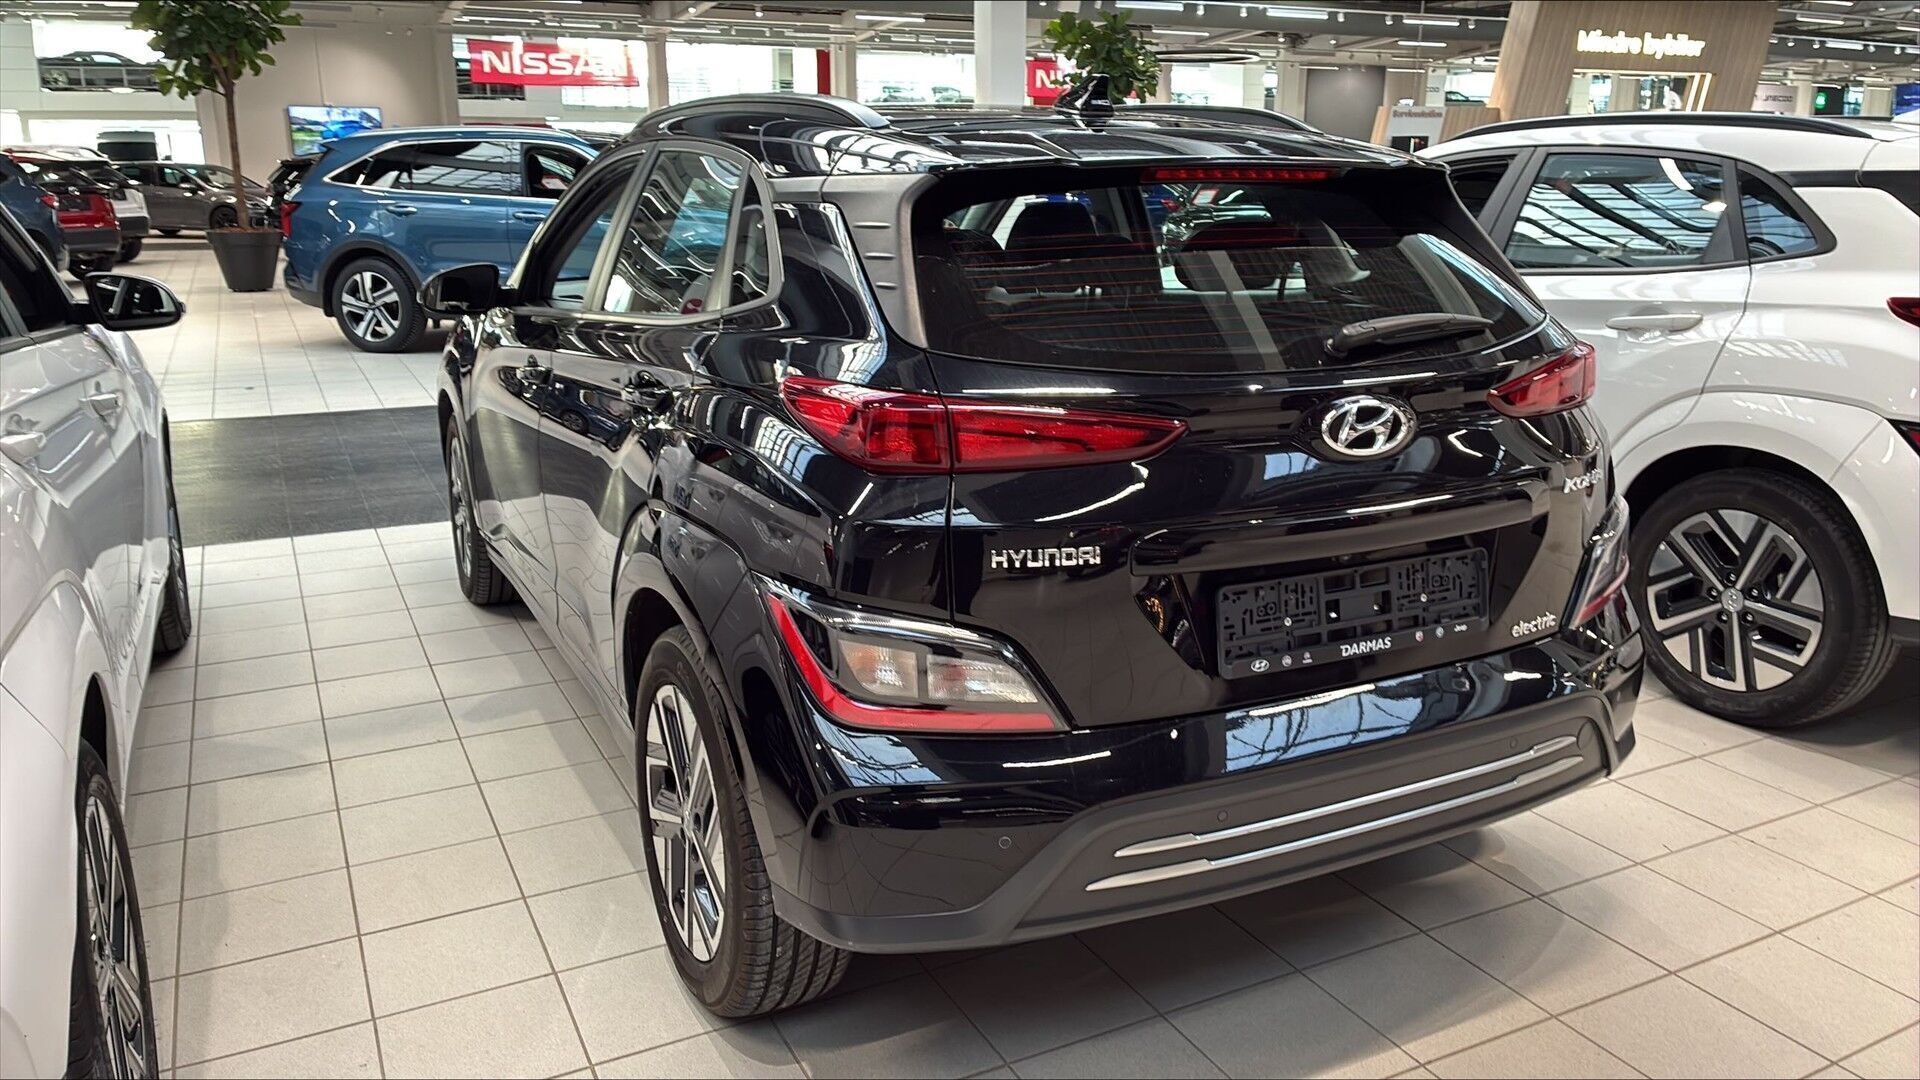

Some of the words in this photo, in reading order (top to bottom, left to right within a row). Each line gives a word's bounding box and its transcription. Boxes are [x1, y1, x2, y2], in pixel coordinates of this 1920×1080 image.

[1577, 29, 1642, 54] Mindre
[990, 545, 1102, 569] HYUNDAI
[1511, 611, 1557, 638] electric
[1340, 636, 1392, 658] DARMAS
